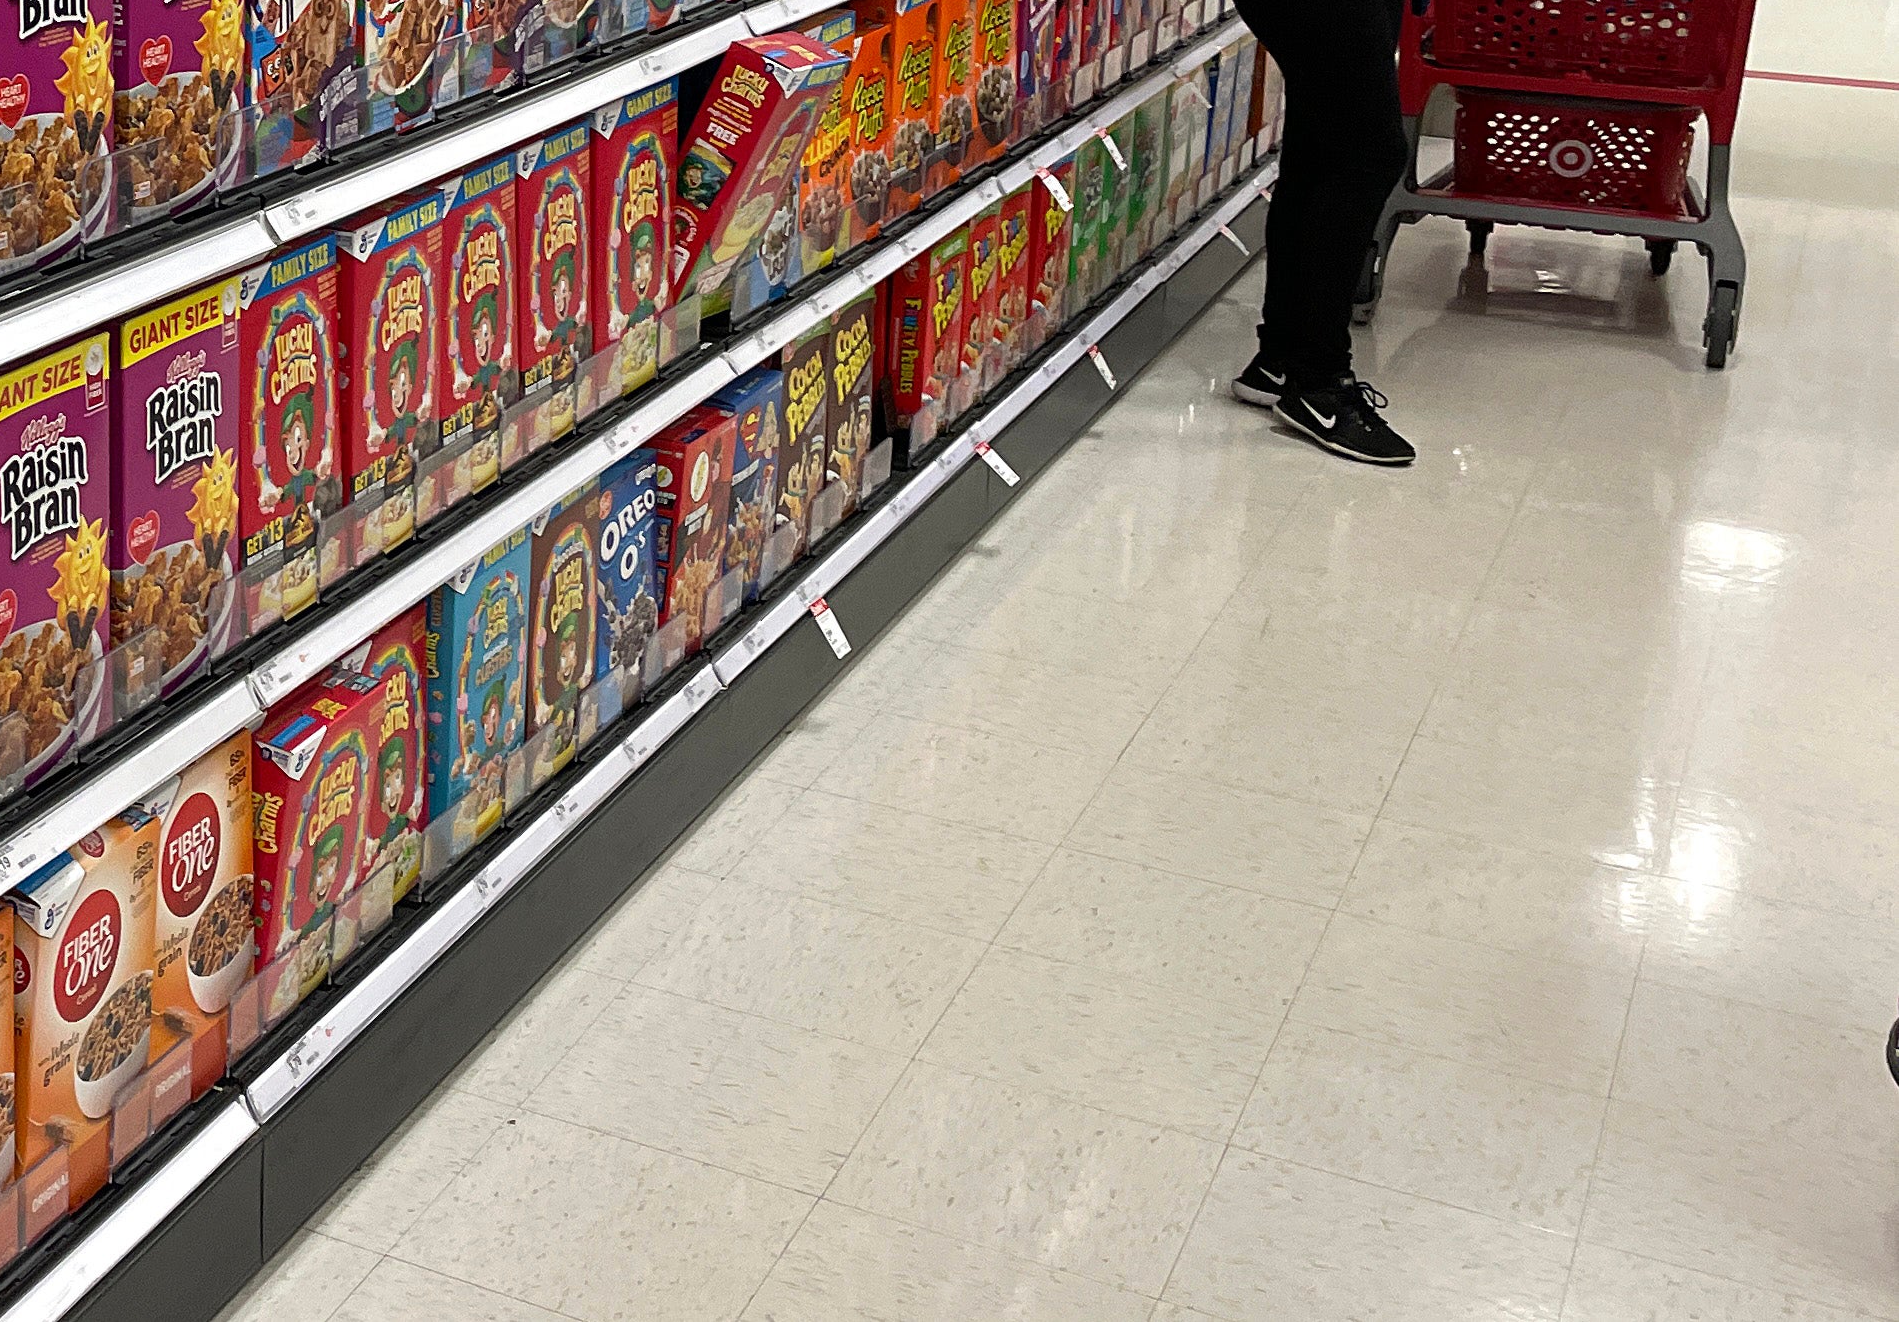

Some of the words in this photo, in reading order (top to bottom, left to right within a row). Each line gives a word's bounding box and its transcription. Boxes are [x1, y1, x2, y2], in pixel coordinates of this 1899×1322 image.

[706, 120, 737, 147] FREE
[271, 257, 304, 288] FAMILY
[306, 245, 328, 274] SIZE
[274, 321, 313, 365] Lucky
[39, 354, 82, 399] SIZE
[270, 355, 318, 404] Charms
[789, 349, 823, 401] COCOA
[785, 369, 826, 447] PEBBLES
[246, 535, 263, 555] GET
[600, 489, 655, 561] OREO
